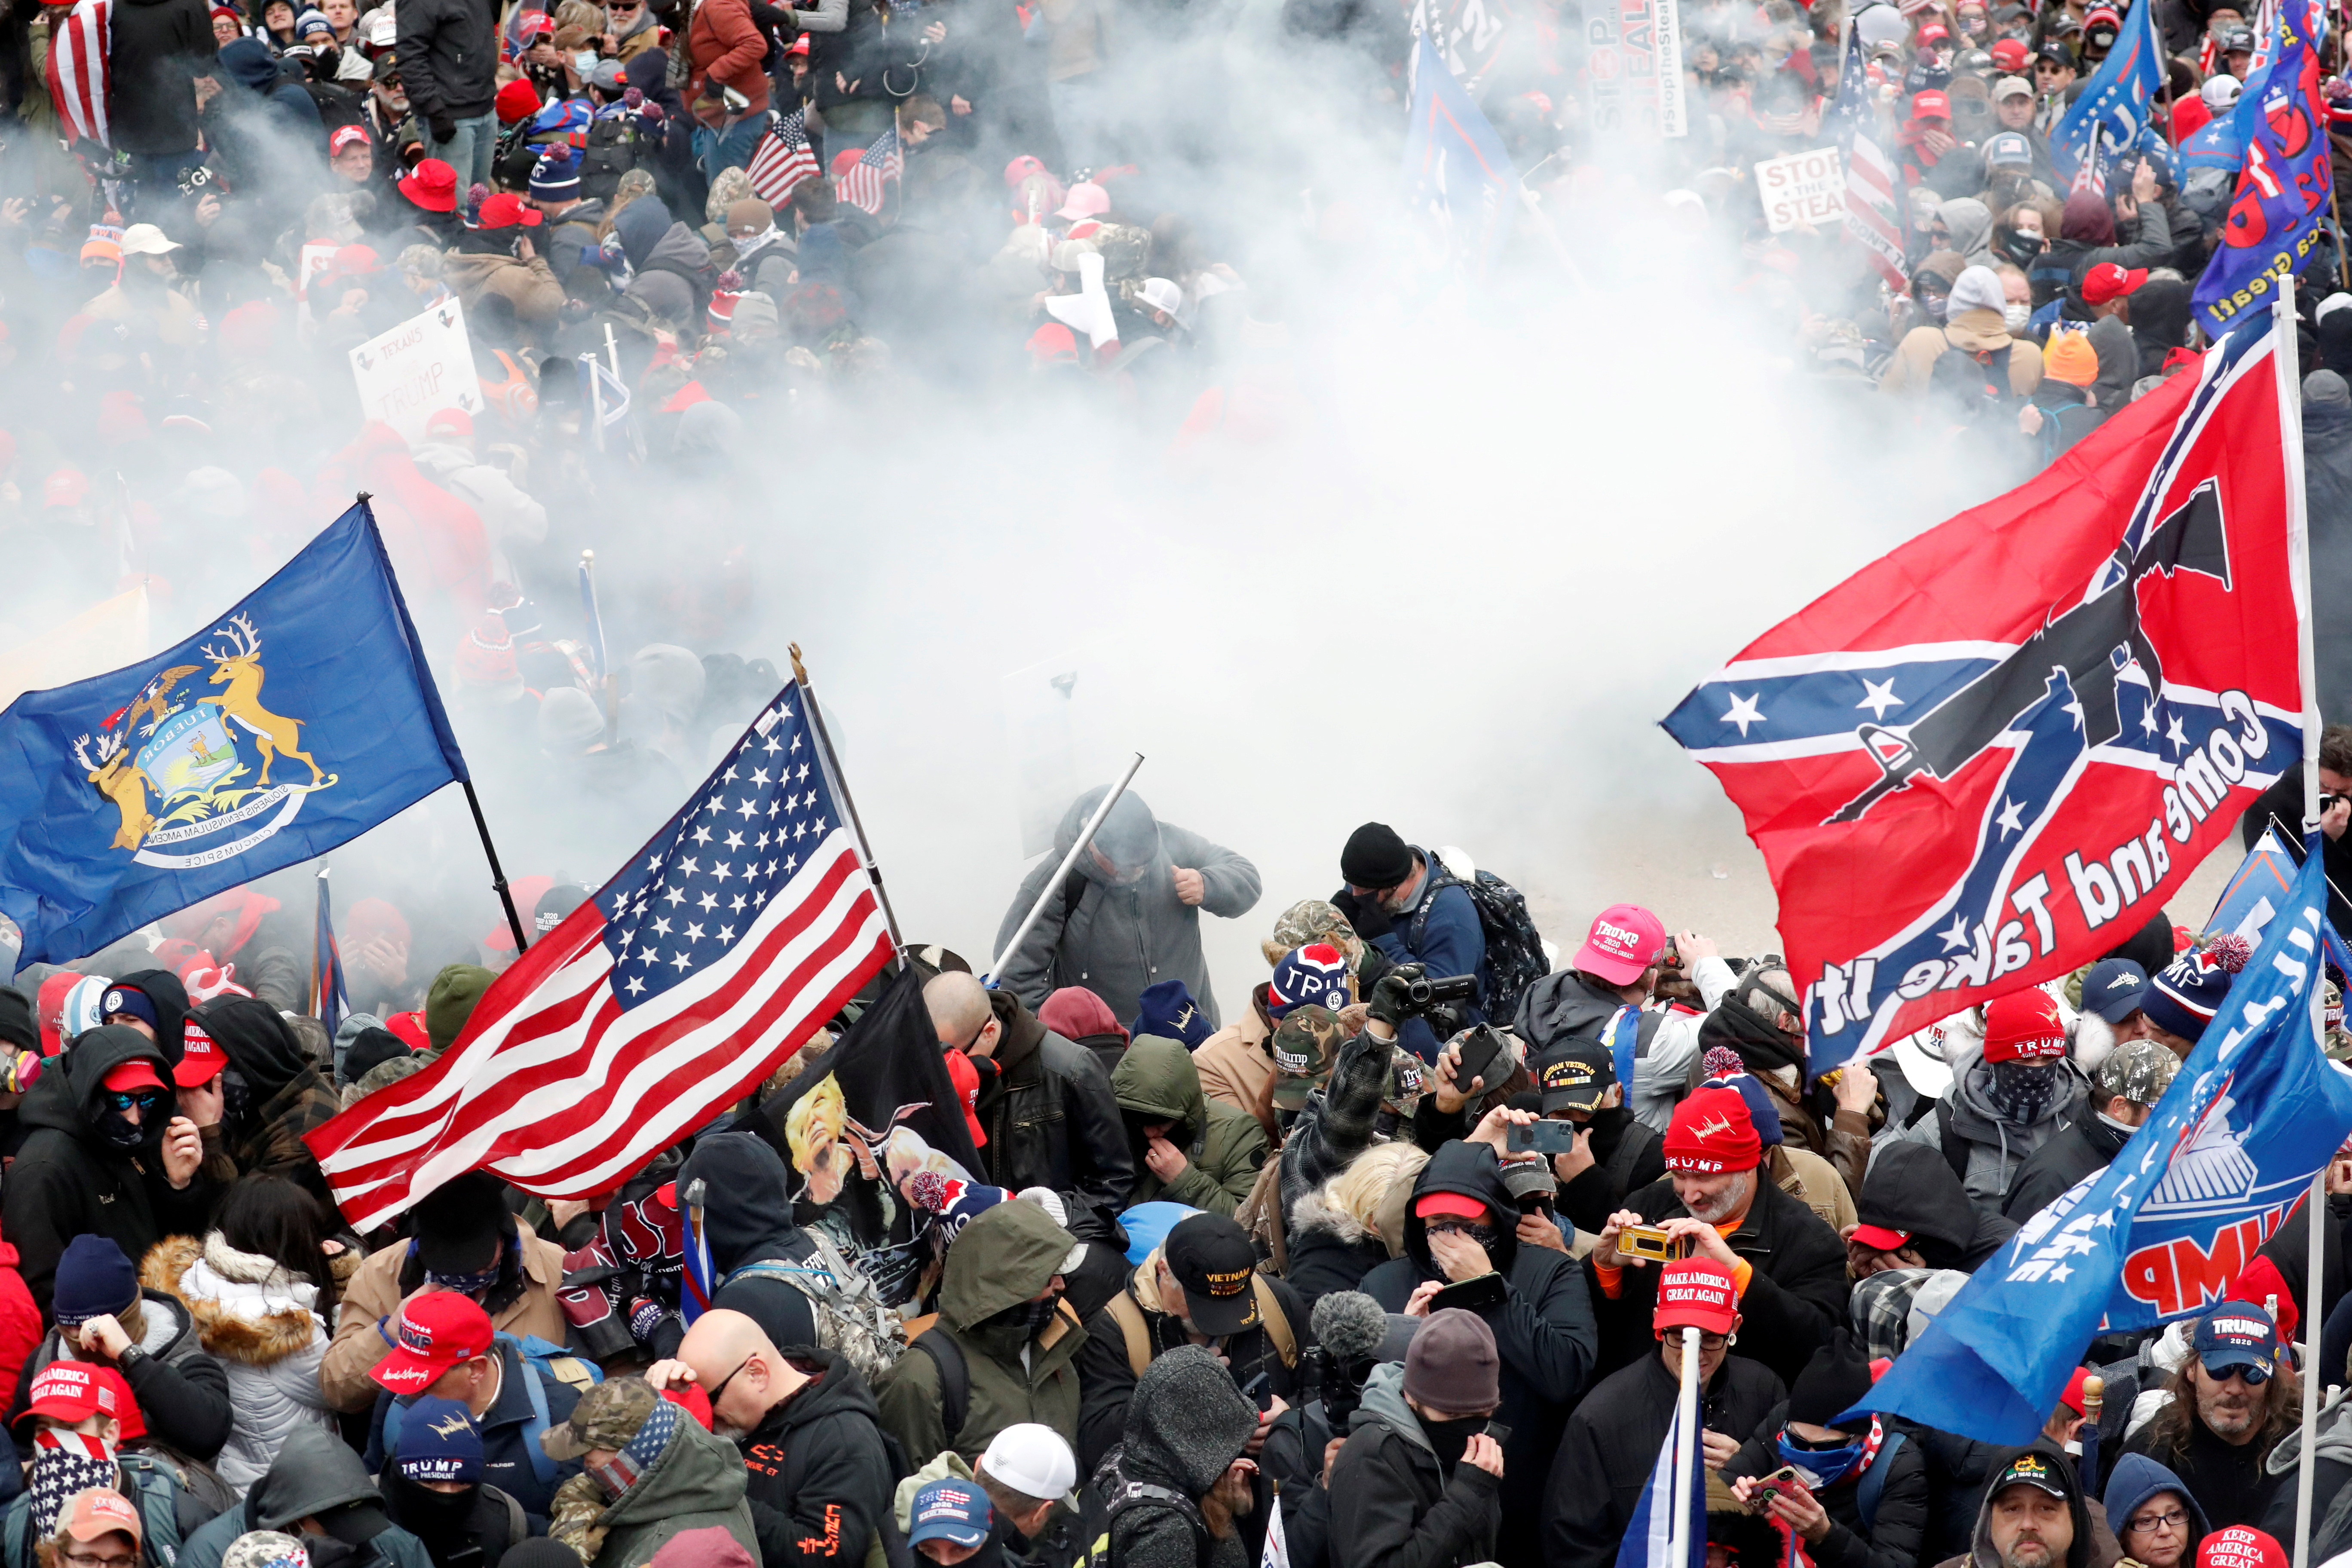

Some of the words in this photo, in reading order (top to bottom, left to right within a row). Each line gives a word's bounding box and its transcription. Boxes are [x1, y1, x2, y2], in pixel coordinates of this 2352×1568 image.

[1794, 181, 1828, 196] THE
[1773, 193, 1845, 225] STEA
[1849, 217, 1893, 254] DON'T
[380, 327, 423, 360] TEXANS
[377, 362, 444, 420] TRUMP
[1595, 920, 1639, 948] TRUMP
[1598, 940, 1618, 955] AMERICA
[1604, 937, 1621, 948] 2020
[108, 995, 118, 1007] 45
[1330, 994, 1339, 1006] 45
[187, 1041, 210, 1053] AGAIN
[2015, 1038, 2065, 1054] TRUMP
[1275, 1045, 1308, 1066] Trump
[1543, 1061, 1565, 1081] VIETNAM
[1565, 1061, 1596, 1075] VETERAN
[1568, 1102, 1592, 1111] VIETNAM
[1666, 1158, 1723, 1172] TRUMP
[98, 1193, 116, 1205] Nick
[1207, 1267, 1250, 1282] VIETNAM
[1663, 1272, 1689, 1286] MAKE
[1688, 1271, 1731, 1291] AMERICA
[1210, 1285, 1245, 1295] VETERAN
[1666, 1288, 1695, 1302] GREAT
[1694, 1291, 1725, 1306] AGAIN
[630, 1304, 658, 1338] TRUMP
[1240, 1311, 1255, 1325] VIETNAM
[2212, 1319, 2269, 1338] TRUMP
[2230, 1337, 2252, 1346] 2020
[410, 1347, 430, 1357] GREAT!
[45, 1368, 91, 1385] AMERICA
[51, 1384, 83, 1398] AGAIN
[401, 1460, 463, 1475] TRUMP
[420, 1471, 455, 1479] PRESIDENT
[2006, 1473, 2017, 1481] DON'T
[919, 1489, 971, 1506] TRUMP
[931, 1501, 952, 1509] 2020
[2222, 1529, 2256, 1545] KEEP
[2206, 1542, 2264, 1563] AMERICA
[2211, 1554, 2254, 1568] GREAT
